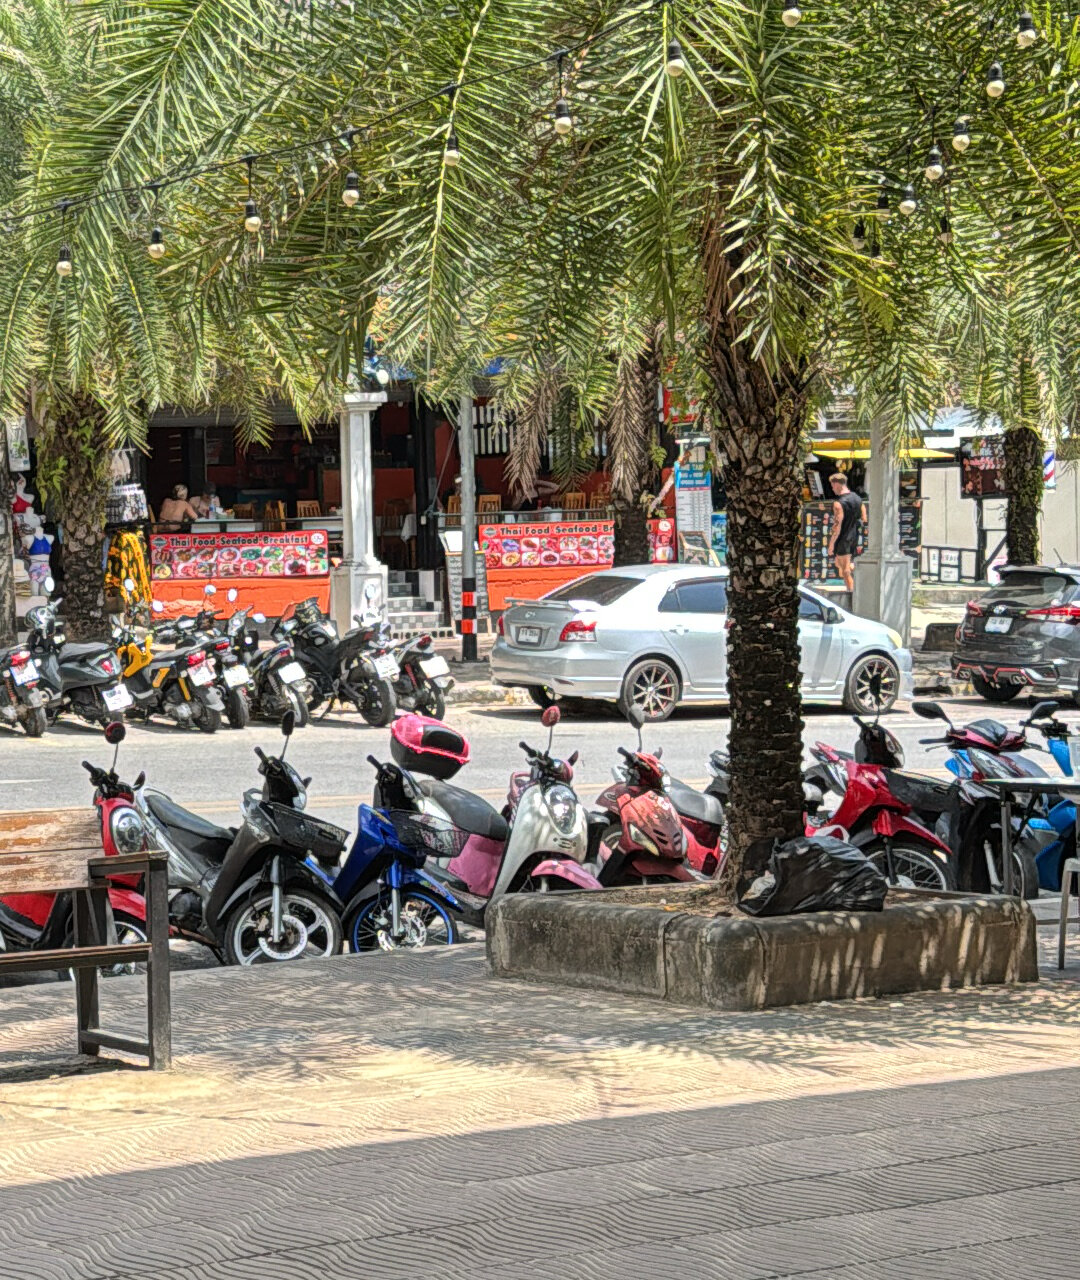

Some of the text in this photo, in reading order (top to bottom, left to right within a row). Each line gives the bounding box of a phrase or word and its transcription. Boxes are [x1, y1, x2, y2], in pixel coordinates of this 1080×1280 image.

[500, 526, 522, 535] Thai
[525, 525, 550, 535] Food
[555, 524, 598, 534] Seafood
[170, 537, 190, 547] Thai
[193, 536, 215, 546] Food
[220, 535, 258, 546] Seafood
[263, 534, 308, 545] Breakfast
